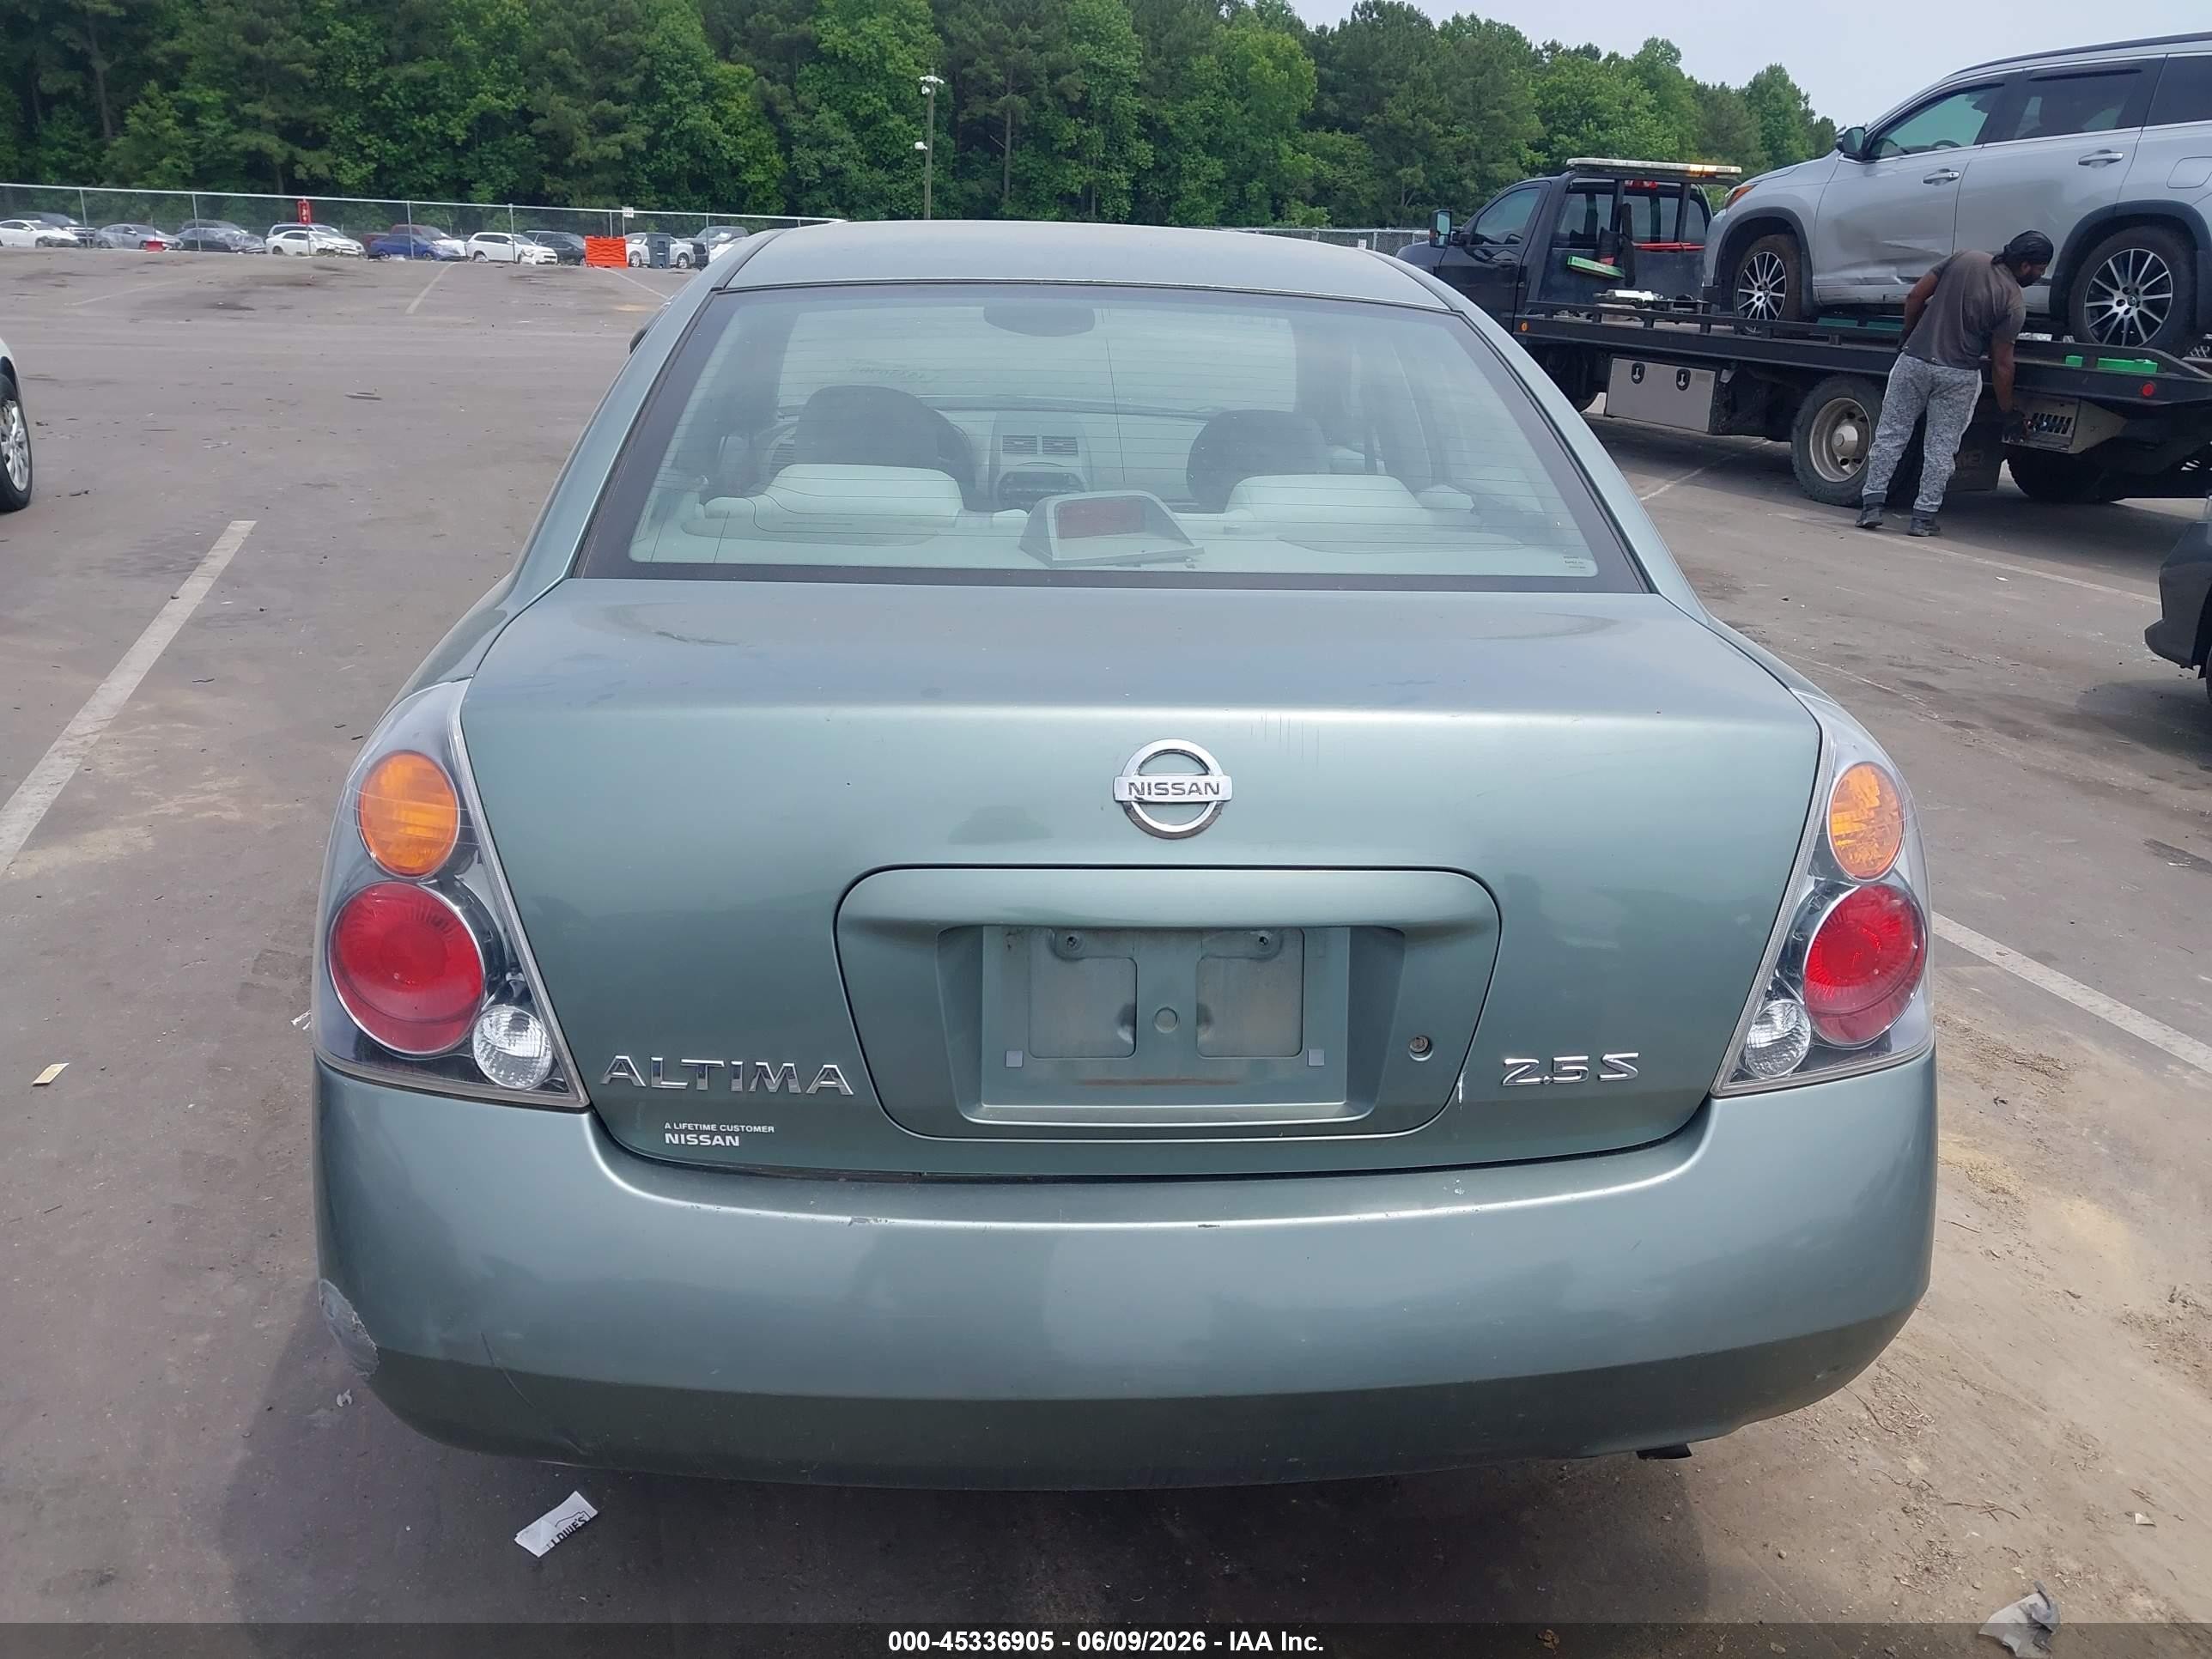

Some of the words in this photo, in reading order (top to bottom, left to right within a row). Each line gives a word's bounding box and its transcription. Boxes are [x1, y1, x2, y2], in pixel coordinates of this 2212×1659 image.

[1127, 781, 1220, 796] NISSAN
[599, 1055, 854, 1095] ALTIMA
[1502, 1054, 1589, 1086] 2.5
[1599, 1052, 1639, 1082] S
[664, 1121, 672, 1130] A
[673, 1122, 718, 1132] LIFETIME
[720, 1124, 775, 1133] CUSTOMER
[664, 1133, 739, 1146] NISSAN
